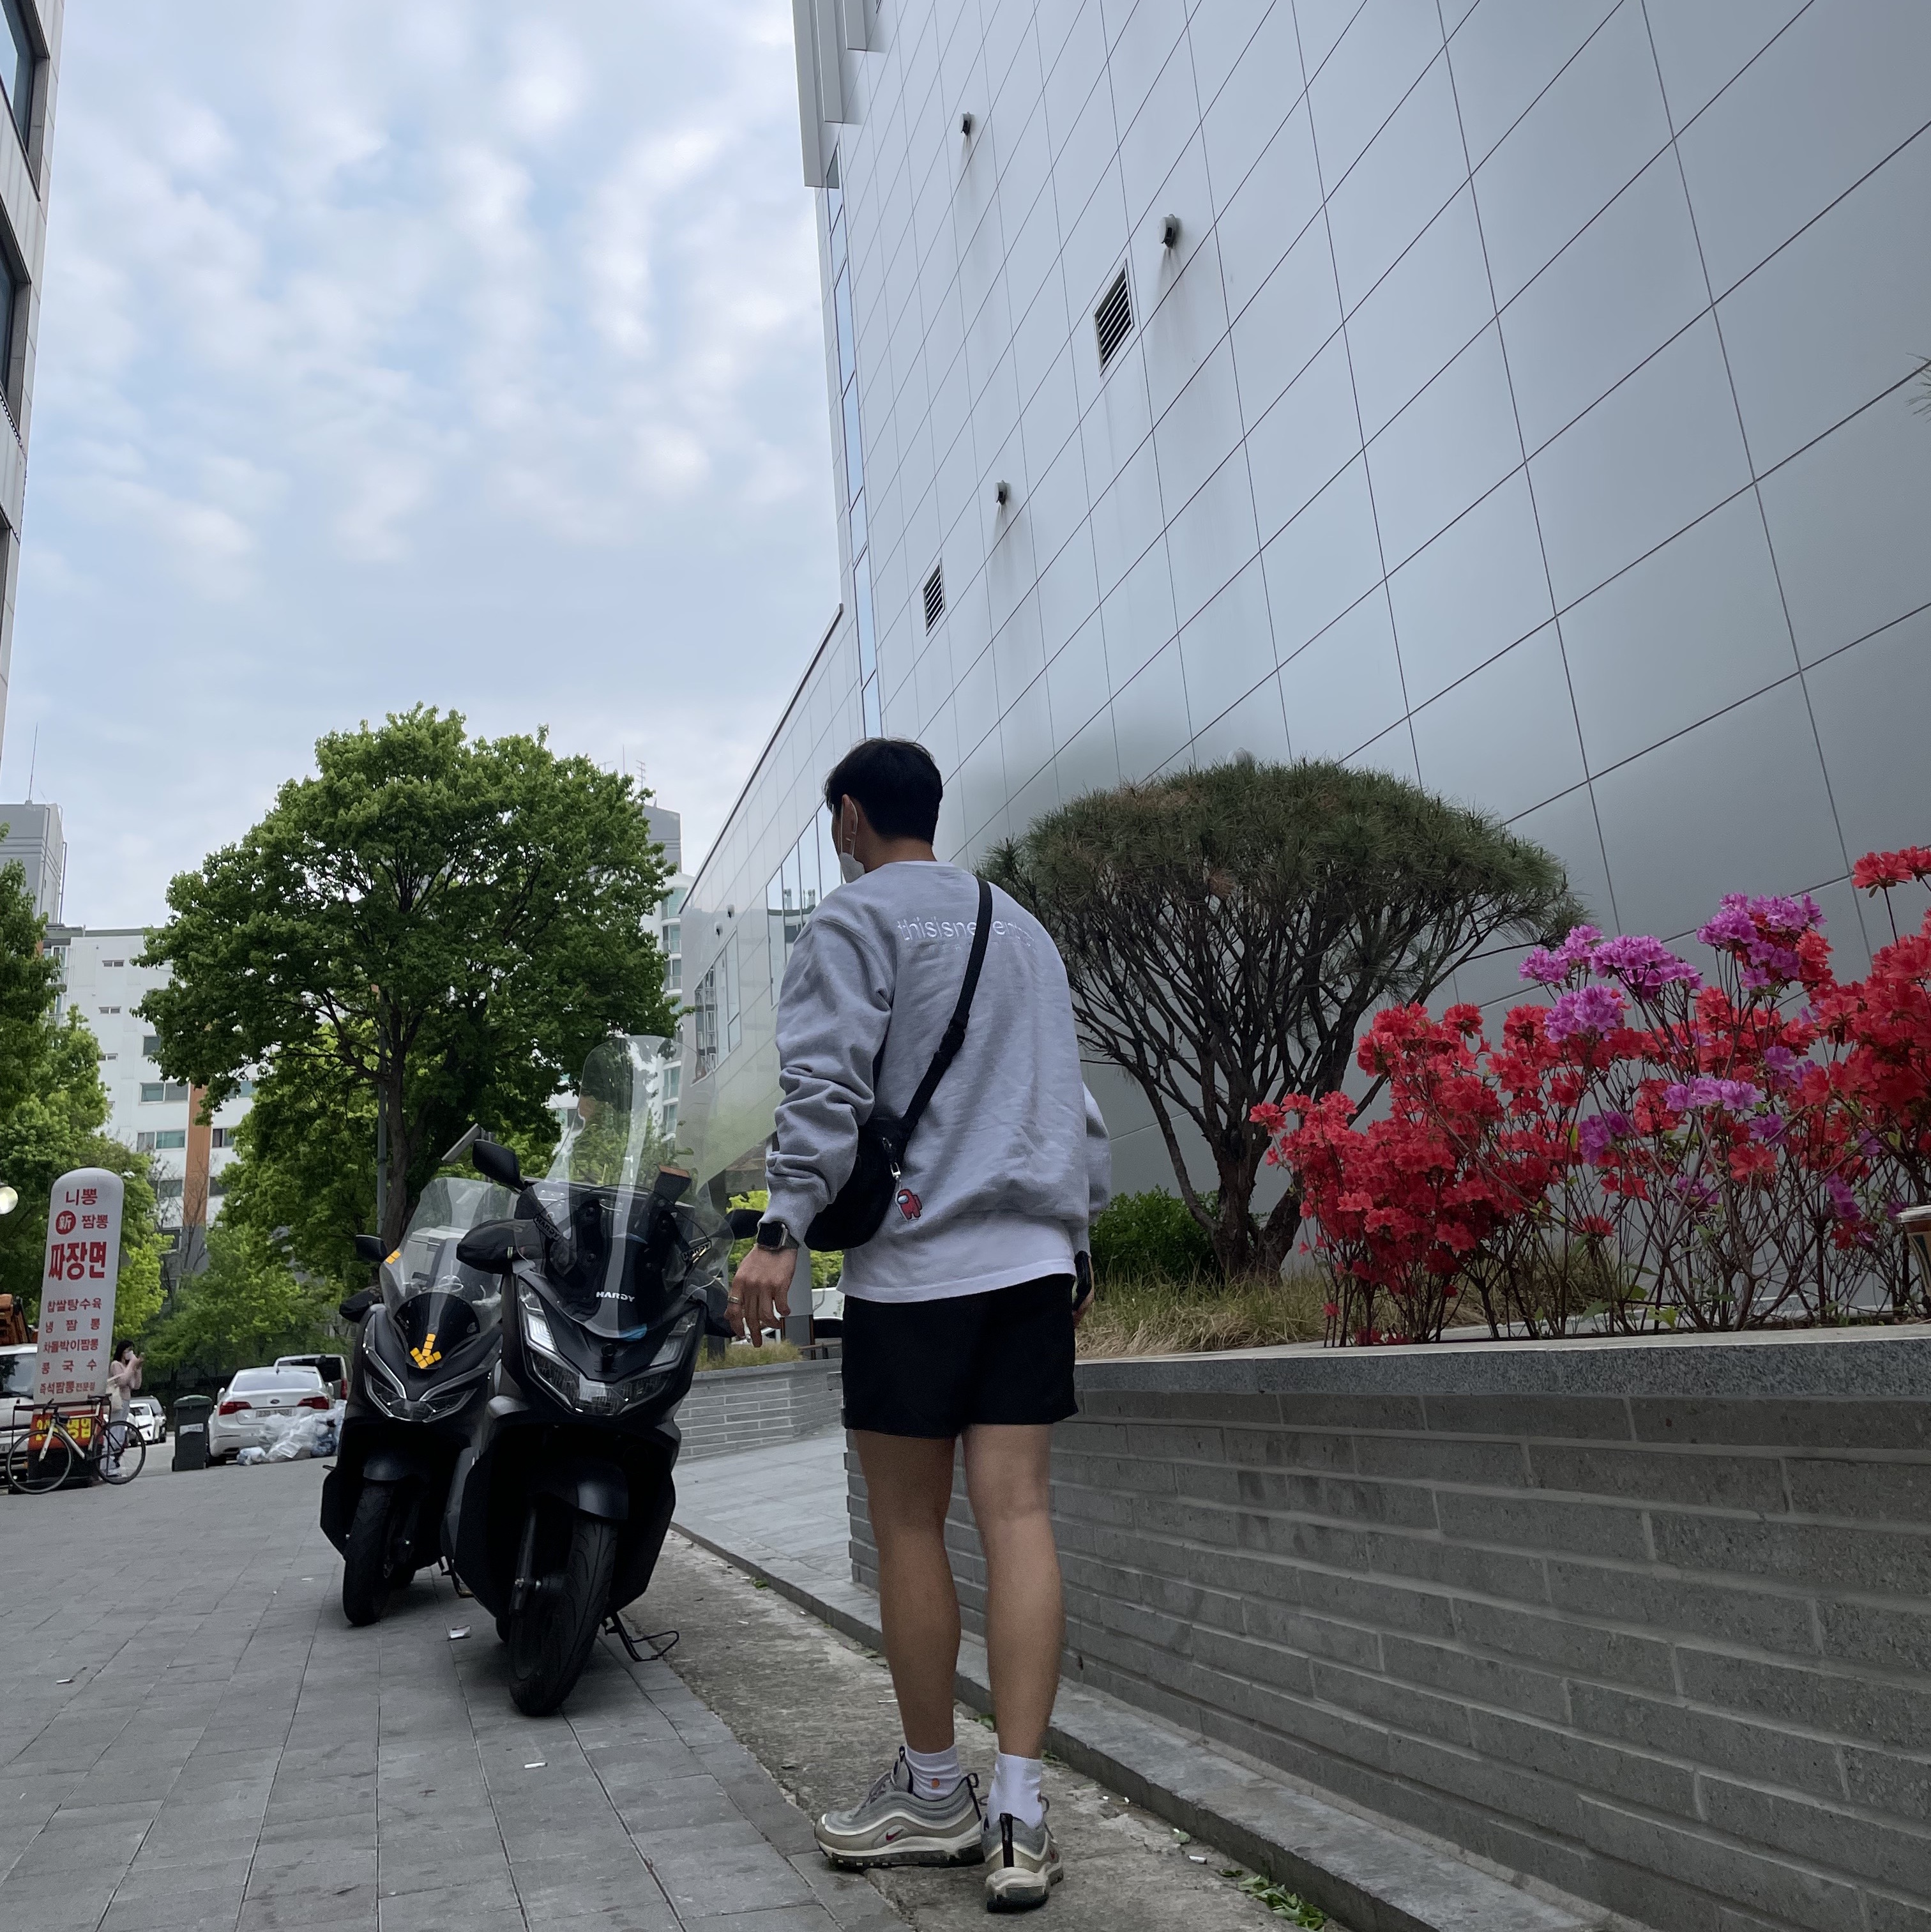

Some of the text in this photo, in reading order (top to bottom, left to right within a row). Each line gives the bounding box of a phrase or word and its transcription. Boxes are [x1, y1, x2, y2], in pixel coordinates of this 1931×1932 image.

[66, 1189, 98, 1206] 니뽕
[81, 1214, 109, 1229] 짬뽕
[49, 1242, 107, 1281] 짜장면
[596, 1291, 635, 1302] HARDY
[47, 1298, 102, 1313] 찹쌀탕수육
